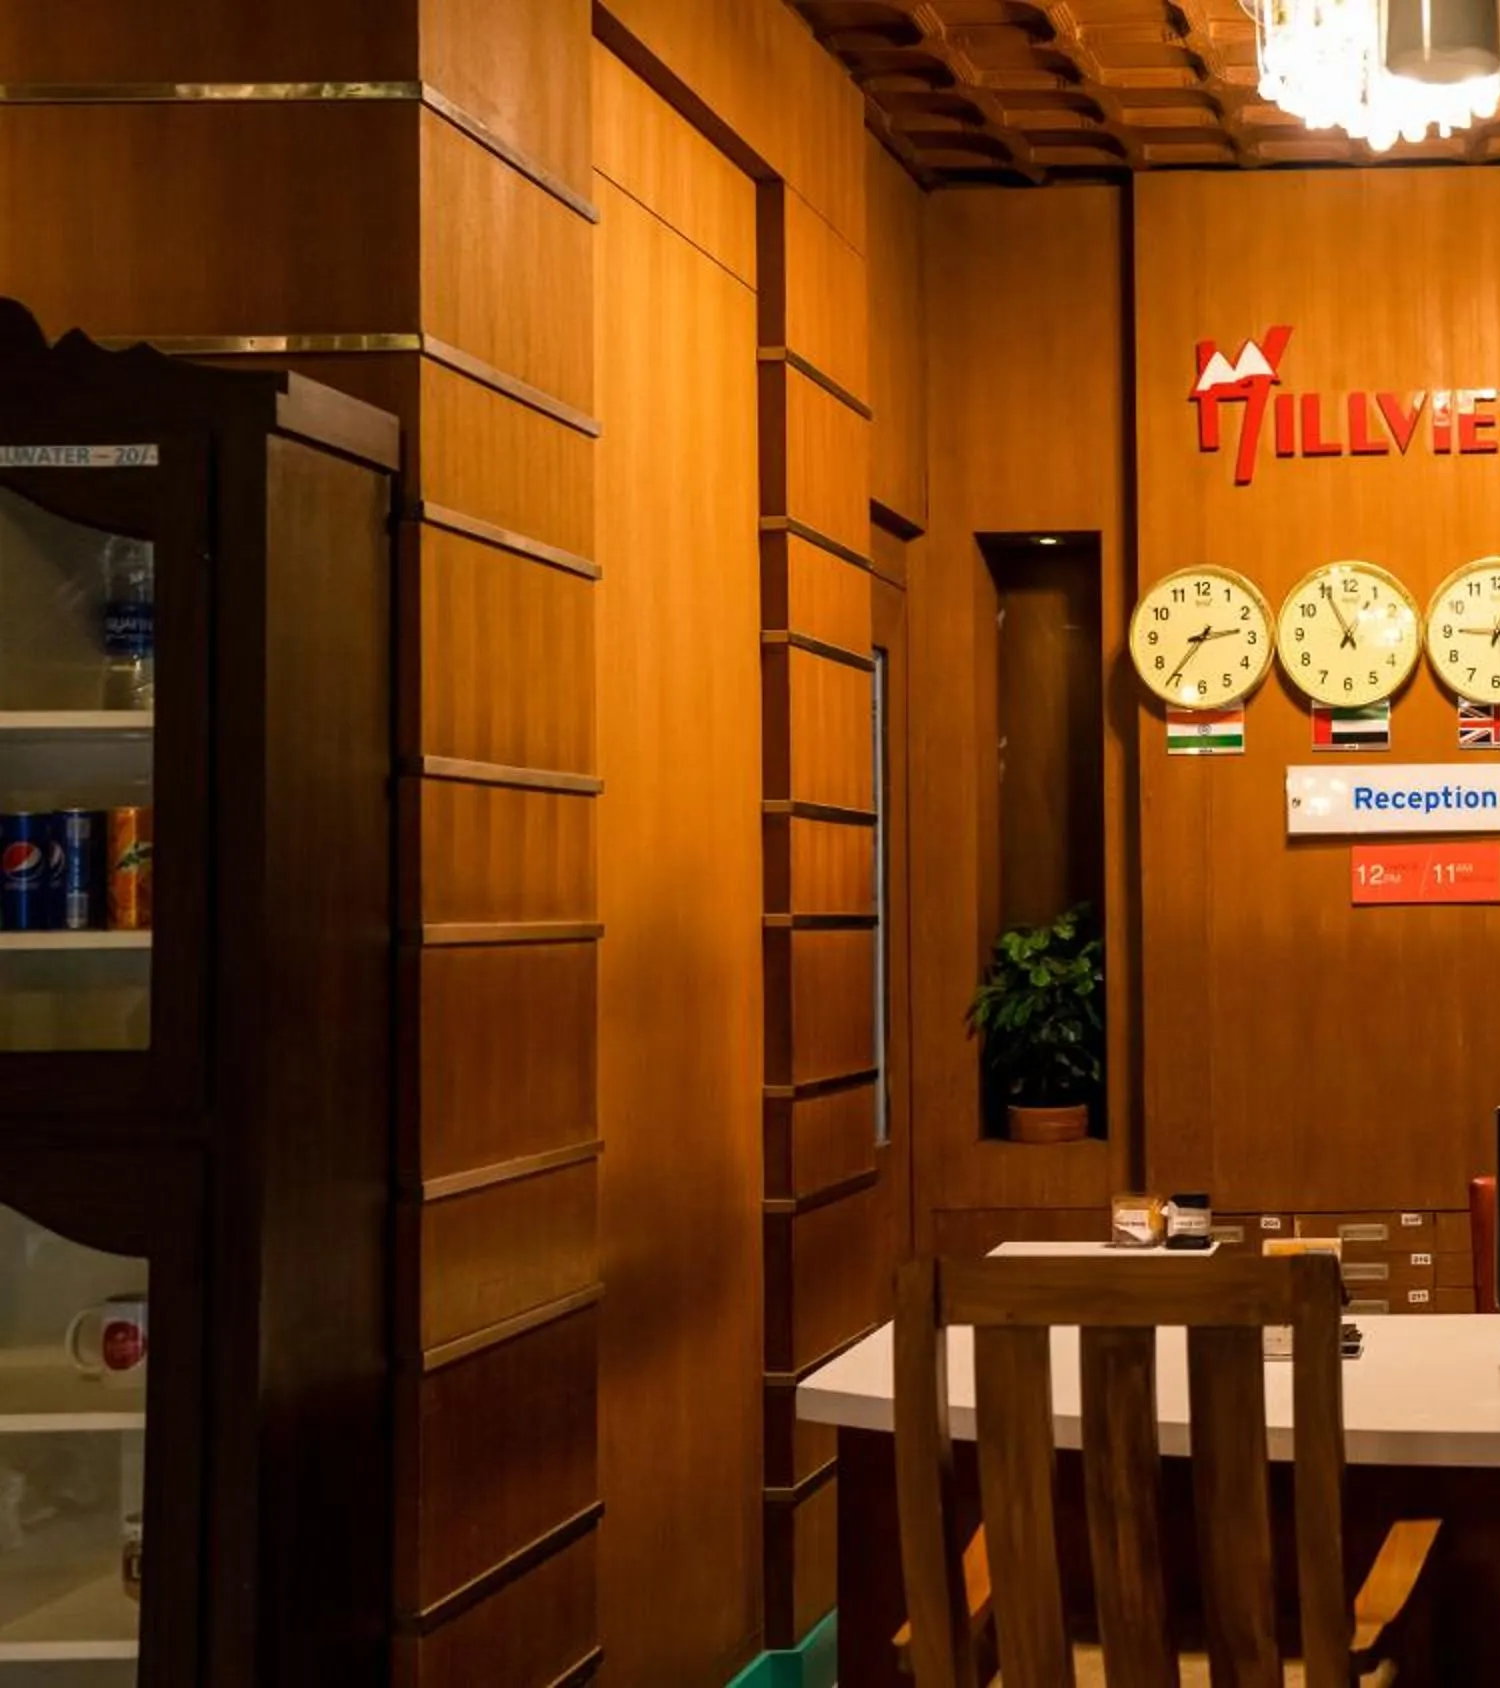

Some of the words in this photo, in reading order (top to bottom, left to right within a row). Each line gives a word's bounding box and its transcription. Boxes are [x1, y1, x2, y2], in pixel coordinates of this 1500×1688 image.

[1194, 582, 1211, 597] 12
[1342, 579, 1359, 593] 12
[1372, 586, 1378, 599] 1
[1467, 583, 1481, 596] 11
[1172, 589, 1185, 603] 11
[1224, 589, 1231, 602] 1
[1240, 607, 1250, 620] 2
[1300, 604, 1316, 617] 10
[1387, 604, 1397, 617] 2
[1450, 601, 1464, 614] 10
[1153, 608, 1169, 621] 10
[1247, 631, 1257, 645] 3
[1295, 628, 1304, 641] 9
[1443, 625, 1452, 638] 9
[1148, 632, 1158, 645] 9
[1155, 656, 1164, 670] 8
[1240, 656, 1250, 669] 4
[1301, 652, 1311, 666] 8
[1386, 653, 1396, 667] 4
[1449, 650, 1458, 663] 8
[1173, 674, 1183, 687] 7
[1222, 674, 1232, 687] 5
[1319, 671, 1329, 684] 7
[1369, 672, 1378, 685] 5
[1467, 668, 1476, 681] 7
[1197, 681, 1207, 695] 6
[1343, 677, 1353, 691] 6
[1491, 675, 1500, 688] 6
[1354, 786, 1498, 813] Reception
[1356, 864, 1384, 886] 12
[1433, 863, 1456, 885] 11
